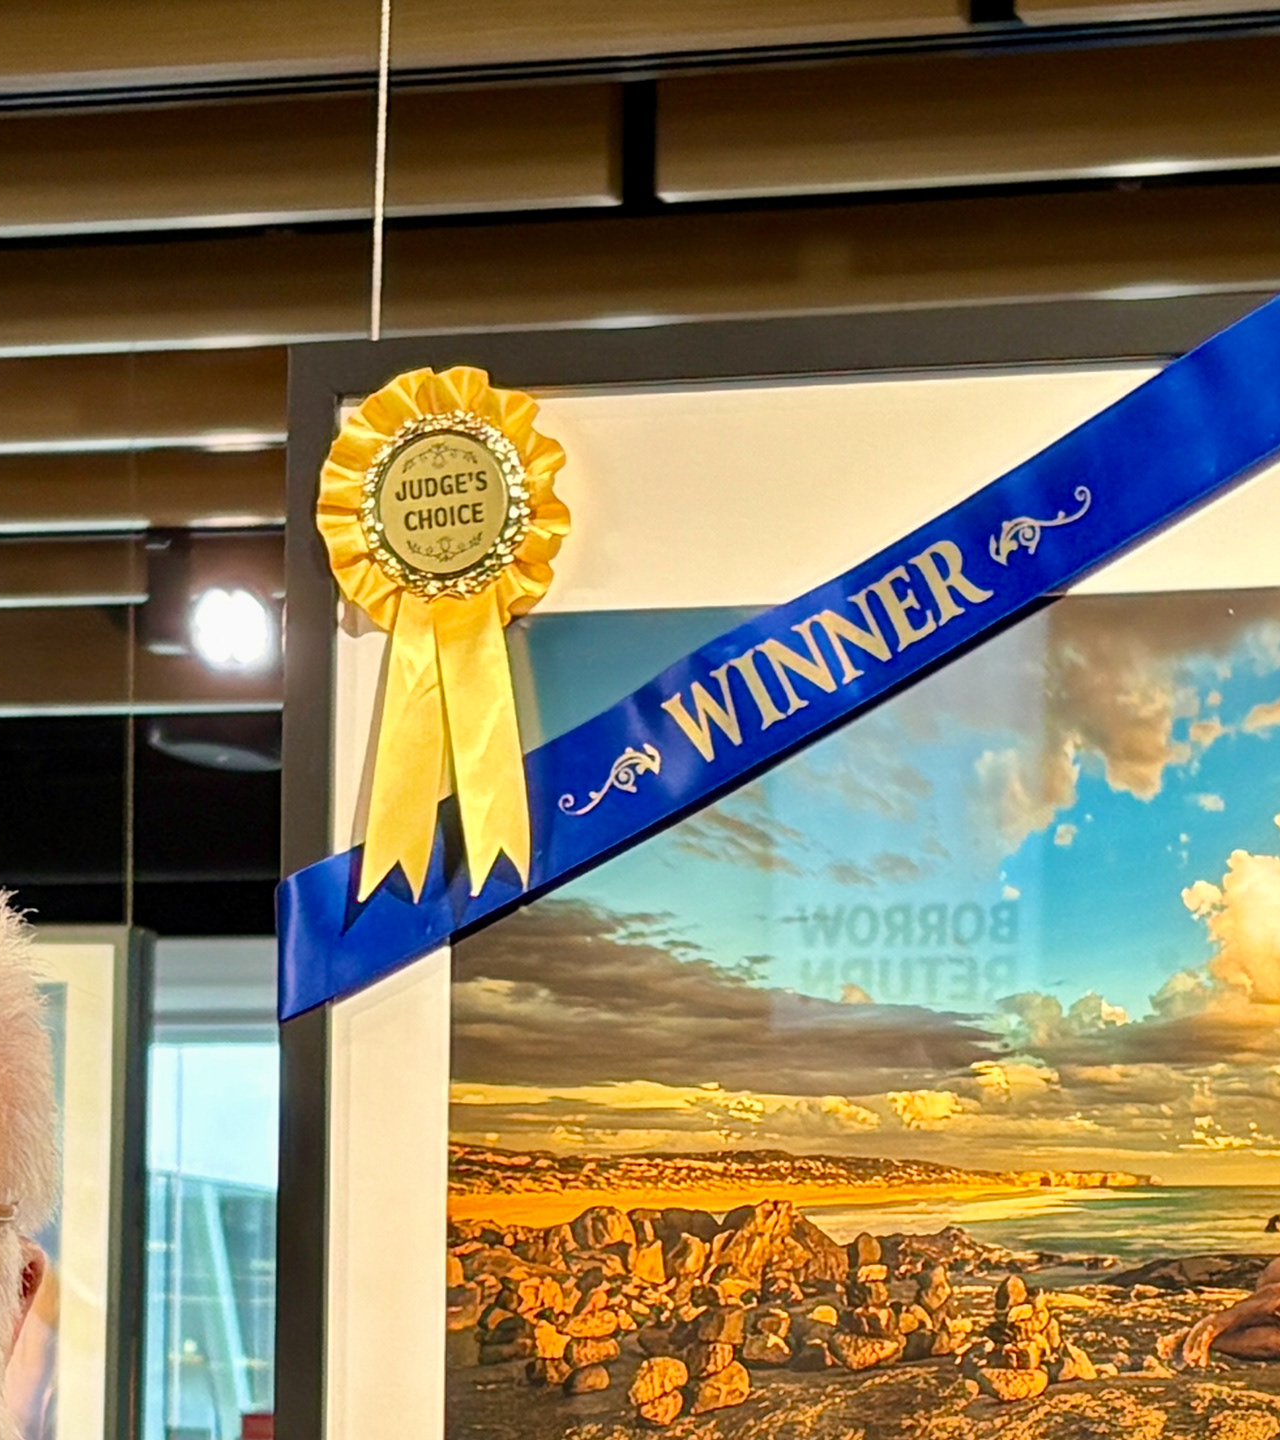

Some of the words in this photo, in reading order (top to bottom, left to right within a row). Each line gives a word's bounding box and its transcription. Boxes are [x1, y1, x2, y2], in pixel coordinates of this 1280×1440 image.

[395, 471, 488, 502] JUDGE'S
[403, 503, 484, 532] CHOICE
[662, 540, 993, 763] WINNER
